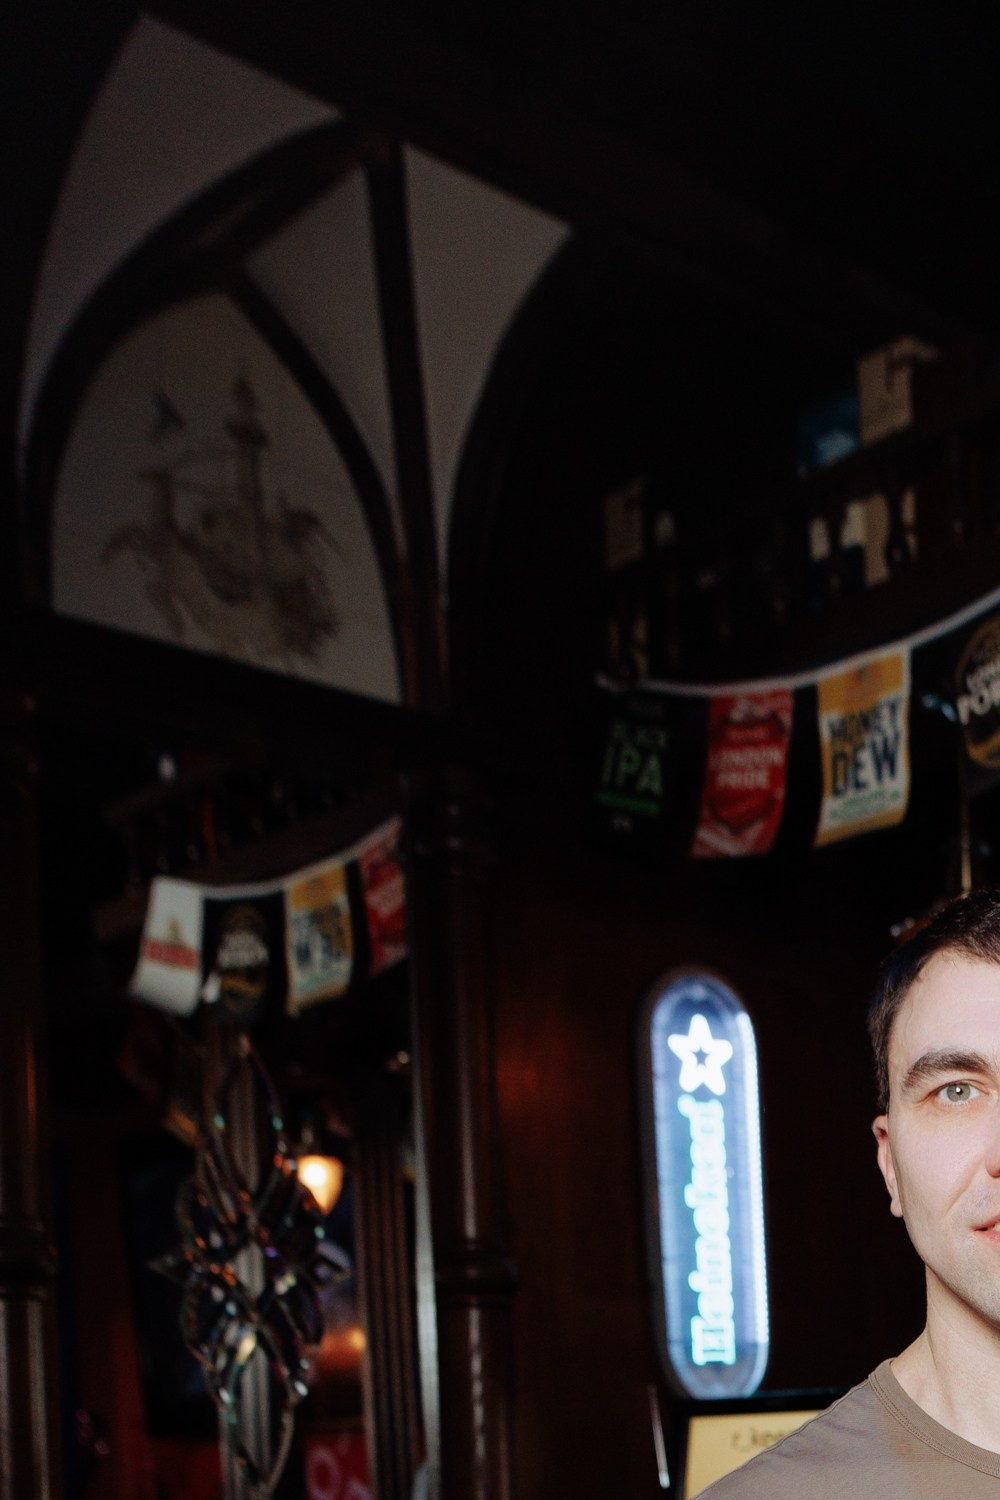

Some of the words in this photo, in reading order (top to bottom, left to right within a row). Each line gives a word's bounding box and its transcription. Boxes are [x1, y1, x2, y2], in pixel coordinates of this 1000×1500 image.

[827, 697, 899, 740] HONEY
[601, 742, 664, 799] IPA
[832, 733, 900, 797] DEW
[678, 1093, 736, 1365] Heineken
